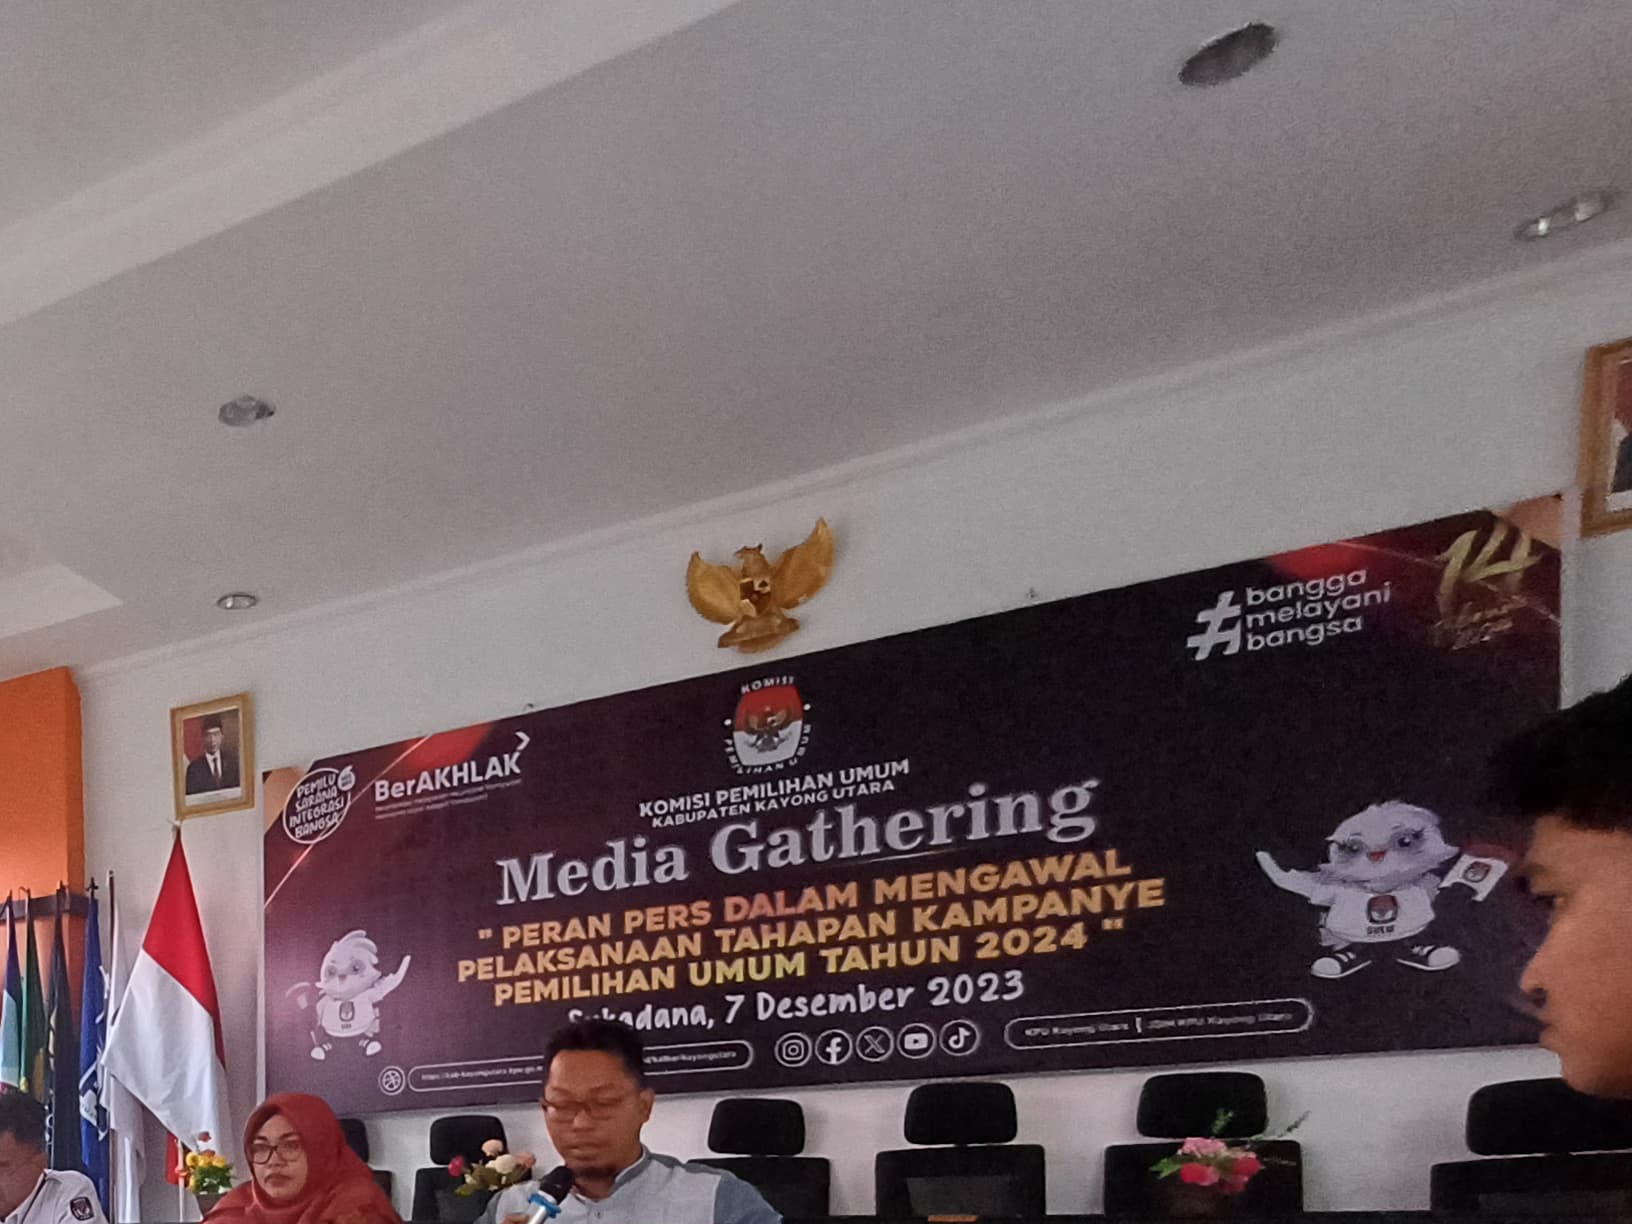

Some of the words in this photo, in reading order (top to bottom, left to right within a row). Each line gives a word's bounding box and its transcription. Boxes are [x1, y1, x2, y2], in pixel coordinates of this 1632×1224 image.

[1246, 569, 1368, 606] bangga
[1246, 582, 1392, 629] melayani
[1247, 615, 1363, 652] bangsa
[295, 786, 338, 812] SARANA
[296, 773, 336, 799] PEMILU
[374, 752, 521, 802] BerAKHLAK
[639, 793, 710, 817] KOMISI
[716, 773, 833, 804] PEMILIHAN
[840, 758, 910, 783] UMUM
[289, 795, 344, 828] INTEGRASI
[295, 812, 338, 839] BANGSA
[652, 805, 750, 828] KABUPATEN
[755, 791, 829, 812] KAYONG
[833, 779, 895, 800] UTARA
[495, 836, 689, 905] Media
[710, 780, 1100, 875] Gathering
[502, 913, 612, 949] PERAN
[623, 901, 711, 935] PERS
[723, 881, 858, 923] DALAM
[874, 849, 1132, 905] MENGAWAL
[457, 931, 702, 983] PELAKSANAAN
[715, 910, 897, 953] TAHAPAN
[912, 877, 1166, 933] KAMPANYE
[494, 966, 676, 1007] PEMILIHAN
[688, 951, 806, 987] UMUM
[819, 935, 961, 974] TAHUN
[974, 922, 1088, 960] 2024
[724, 994, 745, 1024] 7
[757, 983, 915, 1021] Desember
[927, 970, 1024, 1006] 2023
